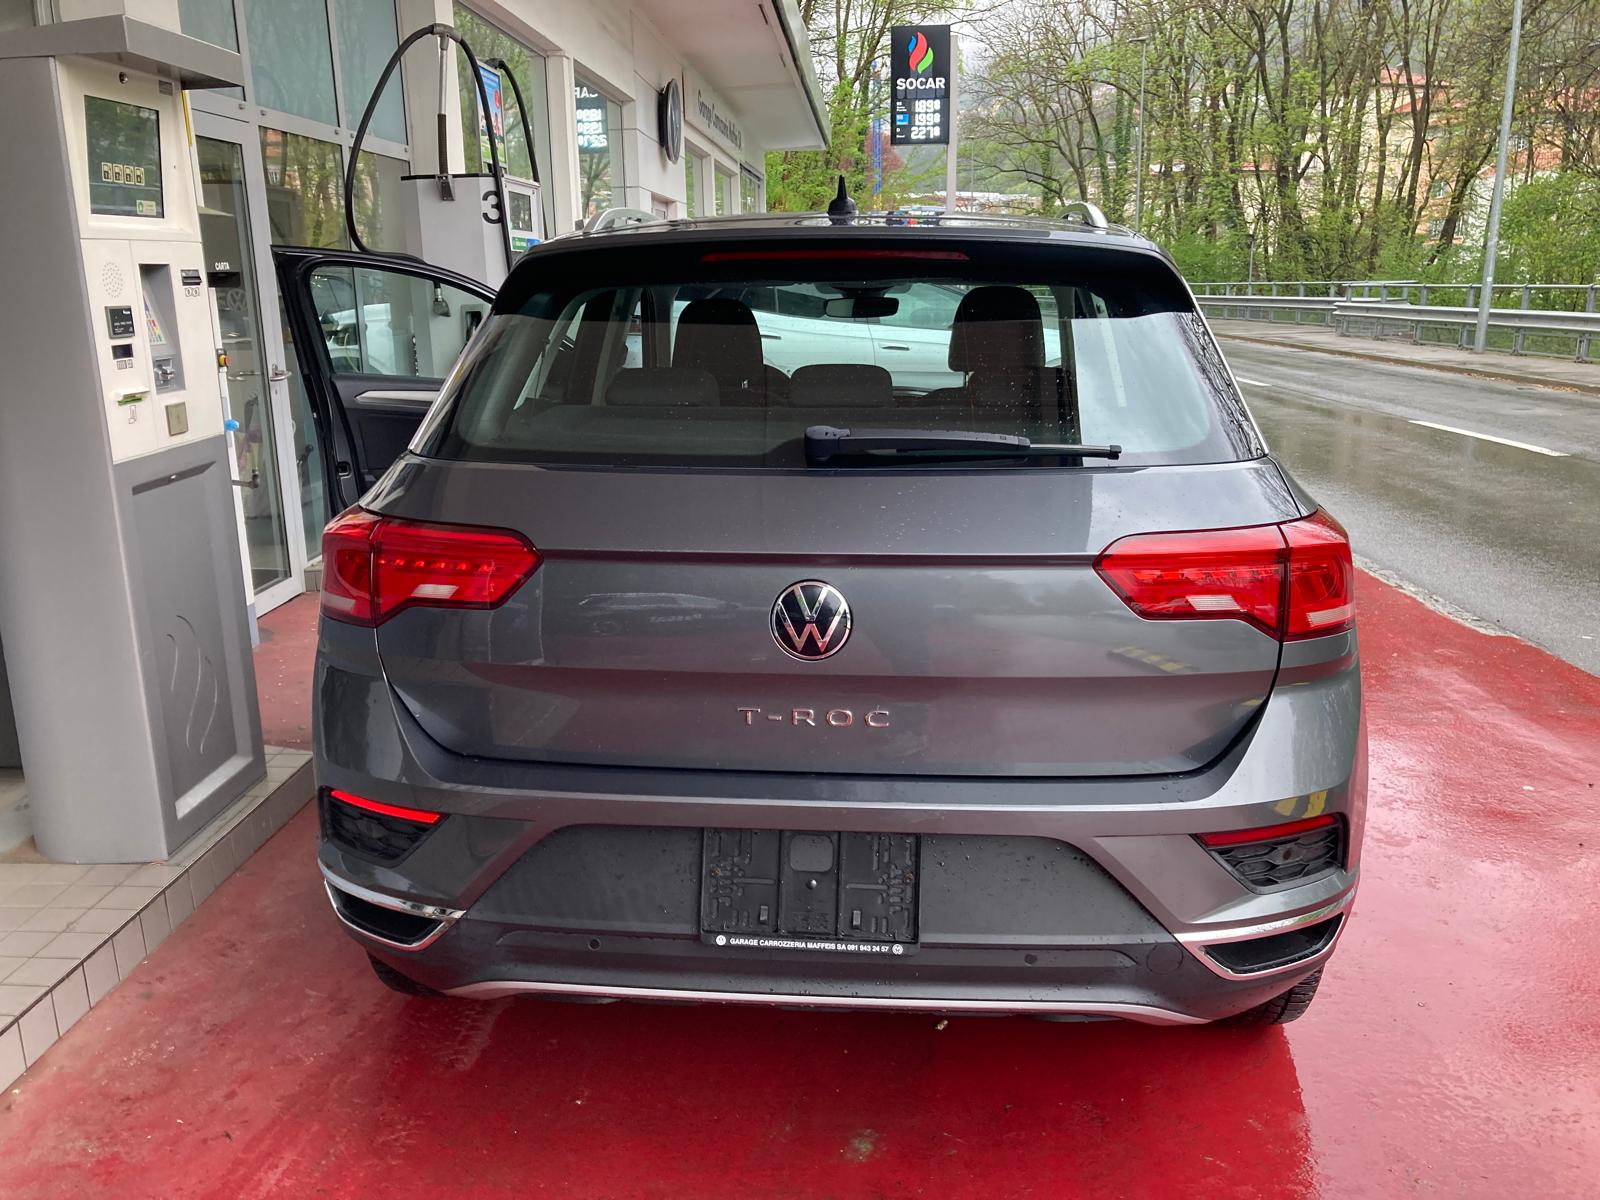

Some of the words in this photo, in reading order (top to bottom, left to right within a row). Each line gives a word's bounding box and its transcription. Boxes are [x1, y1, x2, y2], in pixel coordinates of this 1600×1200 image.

[896, 77, 946, 90] SOCAR
[482, 190, 503, 224] 3
[214, 262, 231, 271] CARTA
[737, 706, 890, 727] T-ROC
[729, 938, 759, 946] GARAGE
[759, 939, 806, 948] CARROZZERIA
